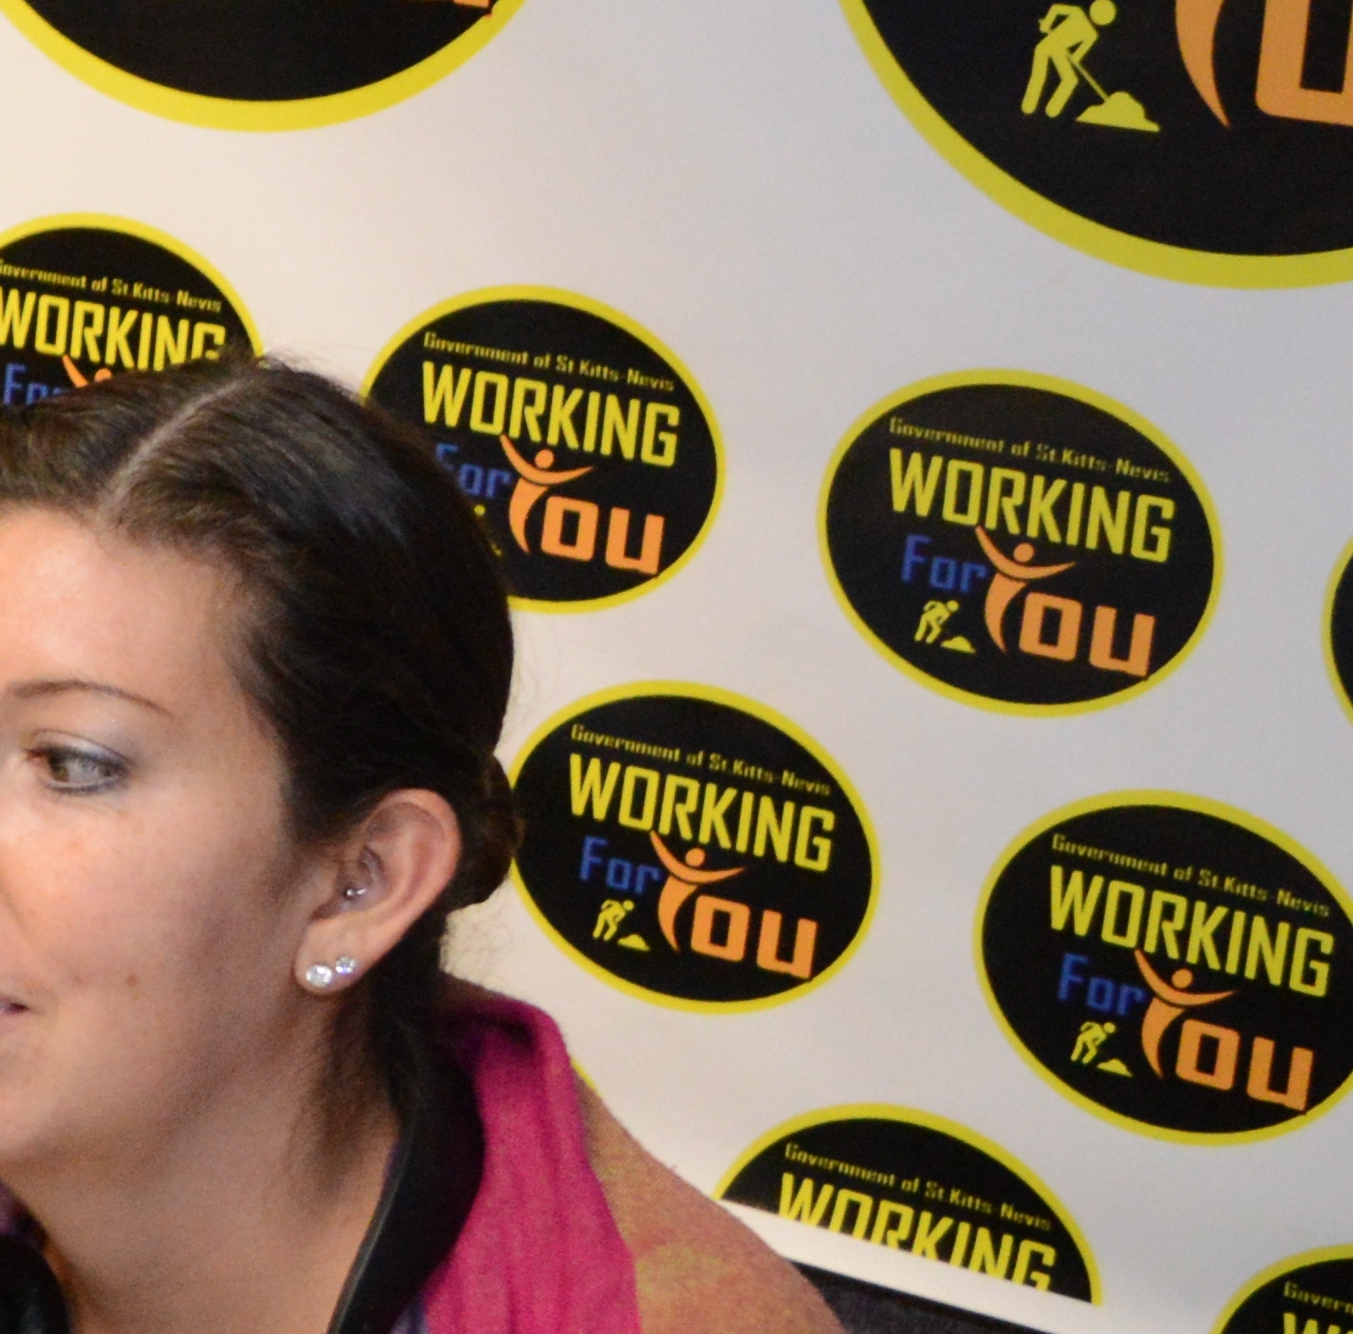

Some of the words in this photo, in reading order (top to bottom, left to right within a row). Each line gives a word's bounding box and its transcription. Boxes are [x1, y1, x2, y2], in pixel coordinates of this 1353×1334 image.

[422, 361, 680, 468] WORKING
[890, 448, 1174, 564] WORKING
[898, 534, 989, 594] For
[571, 754, 835, 873] WORKING
[578, 835, 663, 895] For
[1049, 865, 1335, 998] WORKING
[1055, 952, 1147, 1017] For
